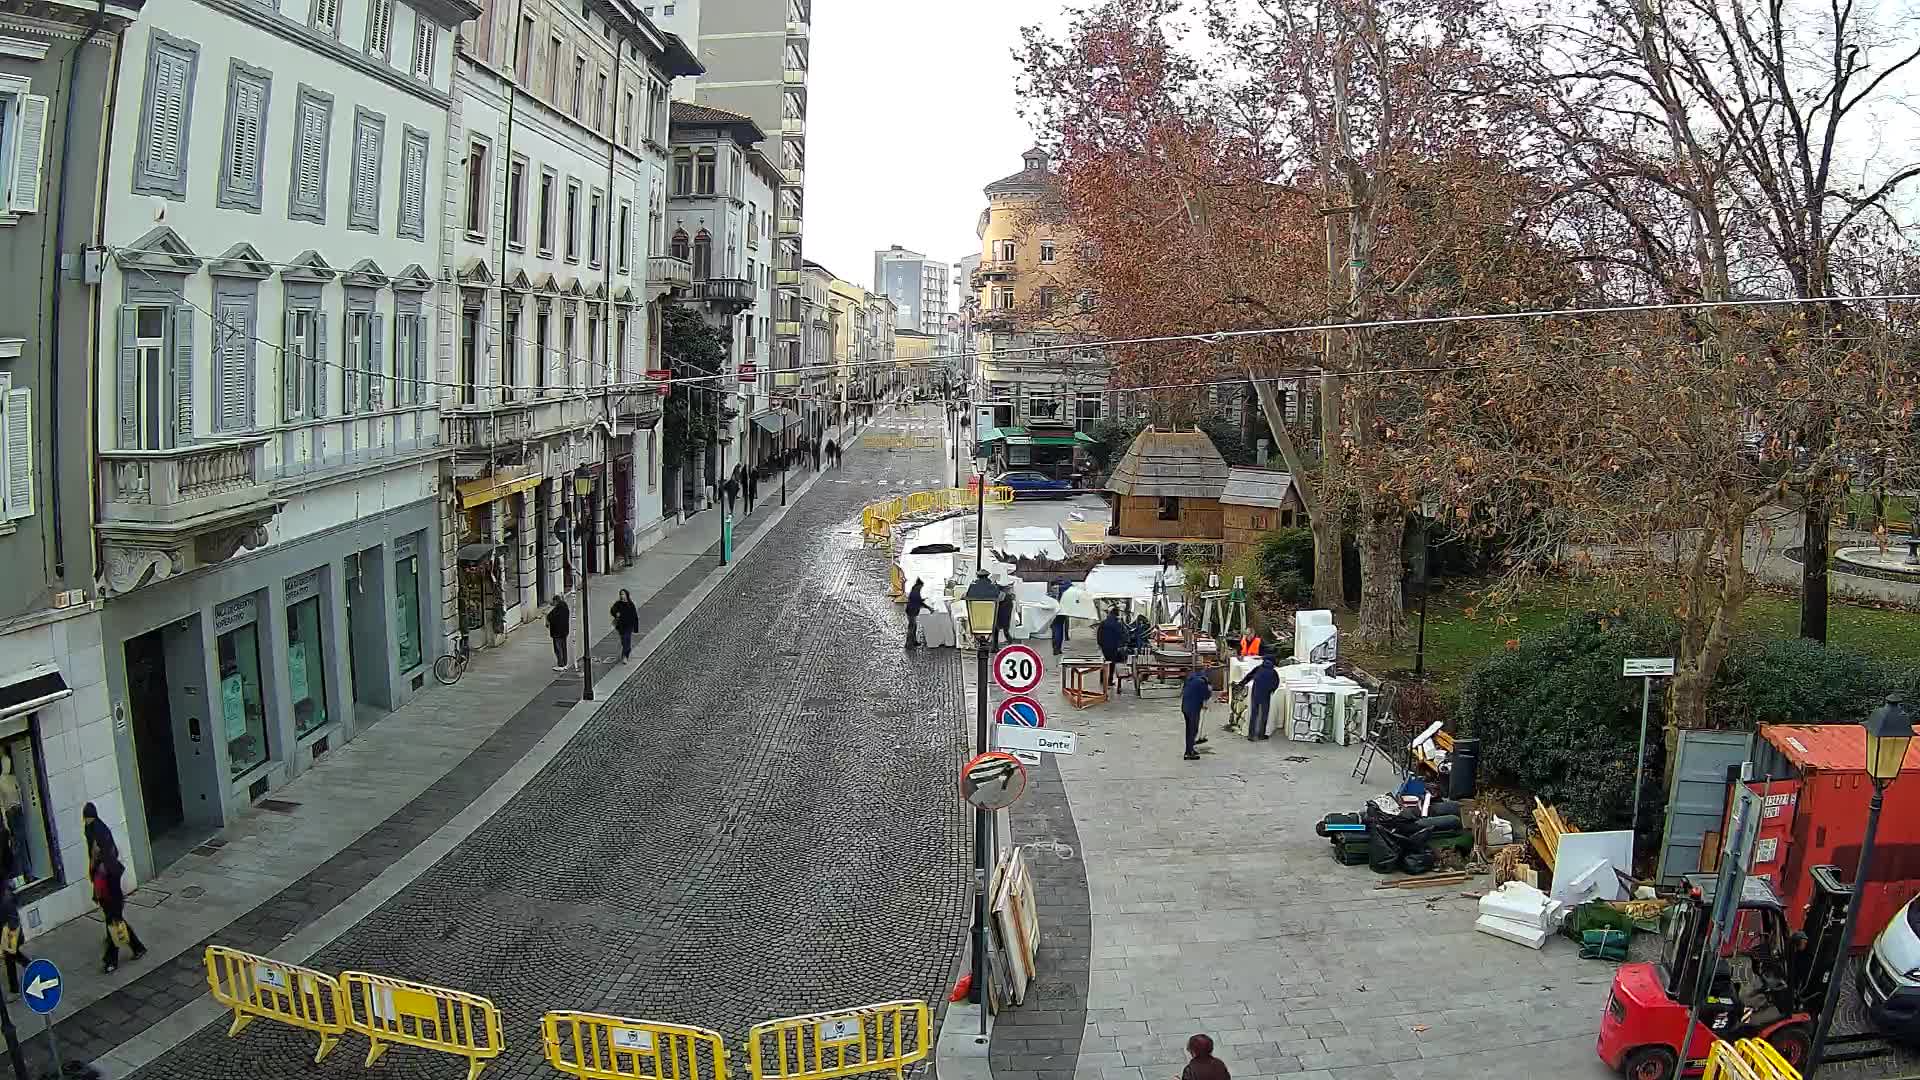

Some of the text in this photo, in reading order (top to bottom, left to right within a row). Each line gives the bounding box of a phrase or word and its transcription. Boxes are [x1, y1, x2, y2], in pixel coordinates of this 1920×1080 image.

[1005, 659, 1032, 680] 30
[1038, 738, 1070, 749] Dante
[1712, 1018, 1727, 1029] 25
